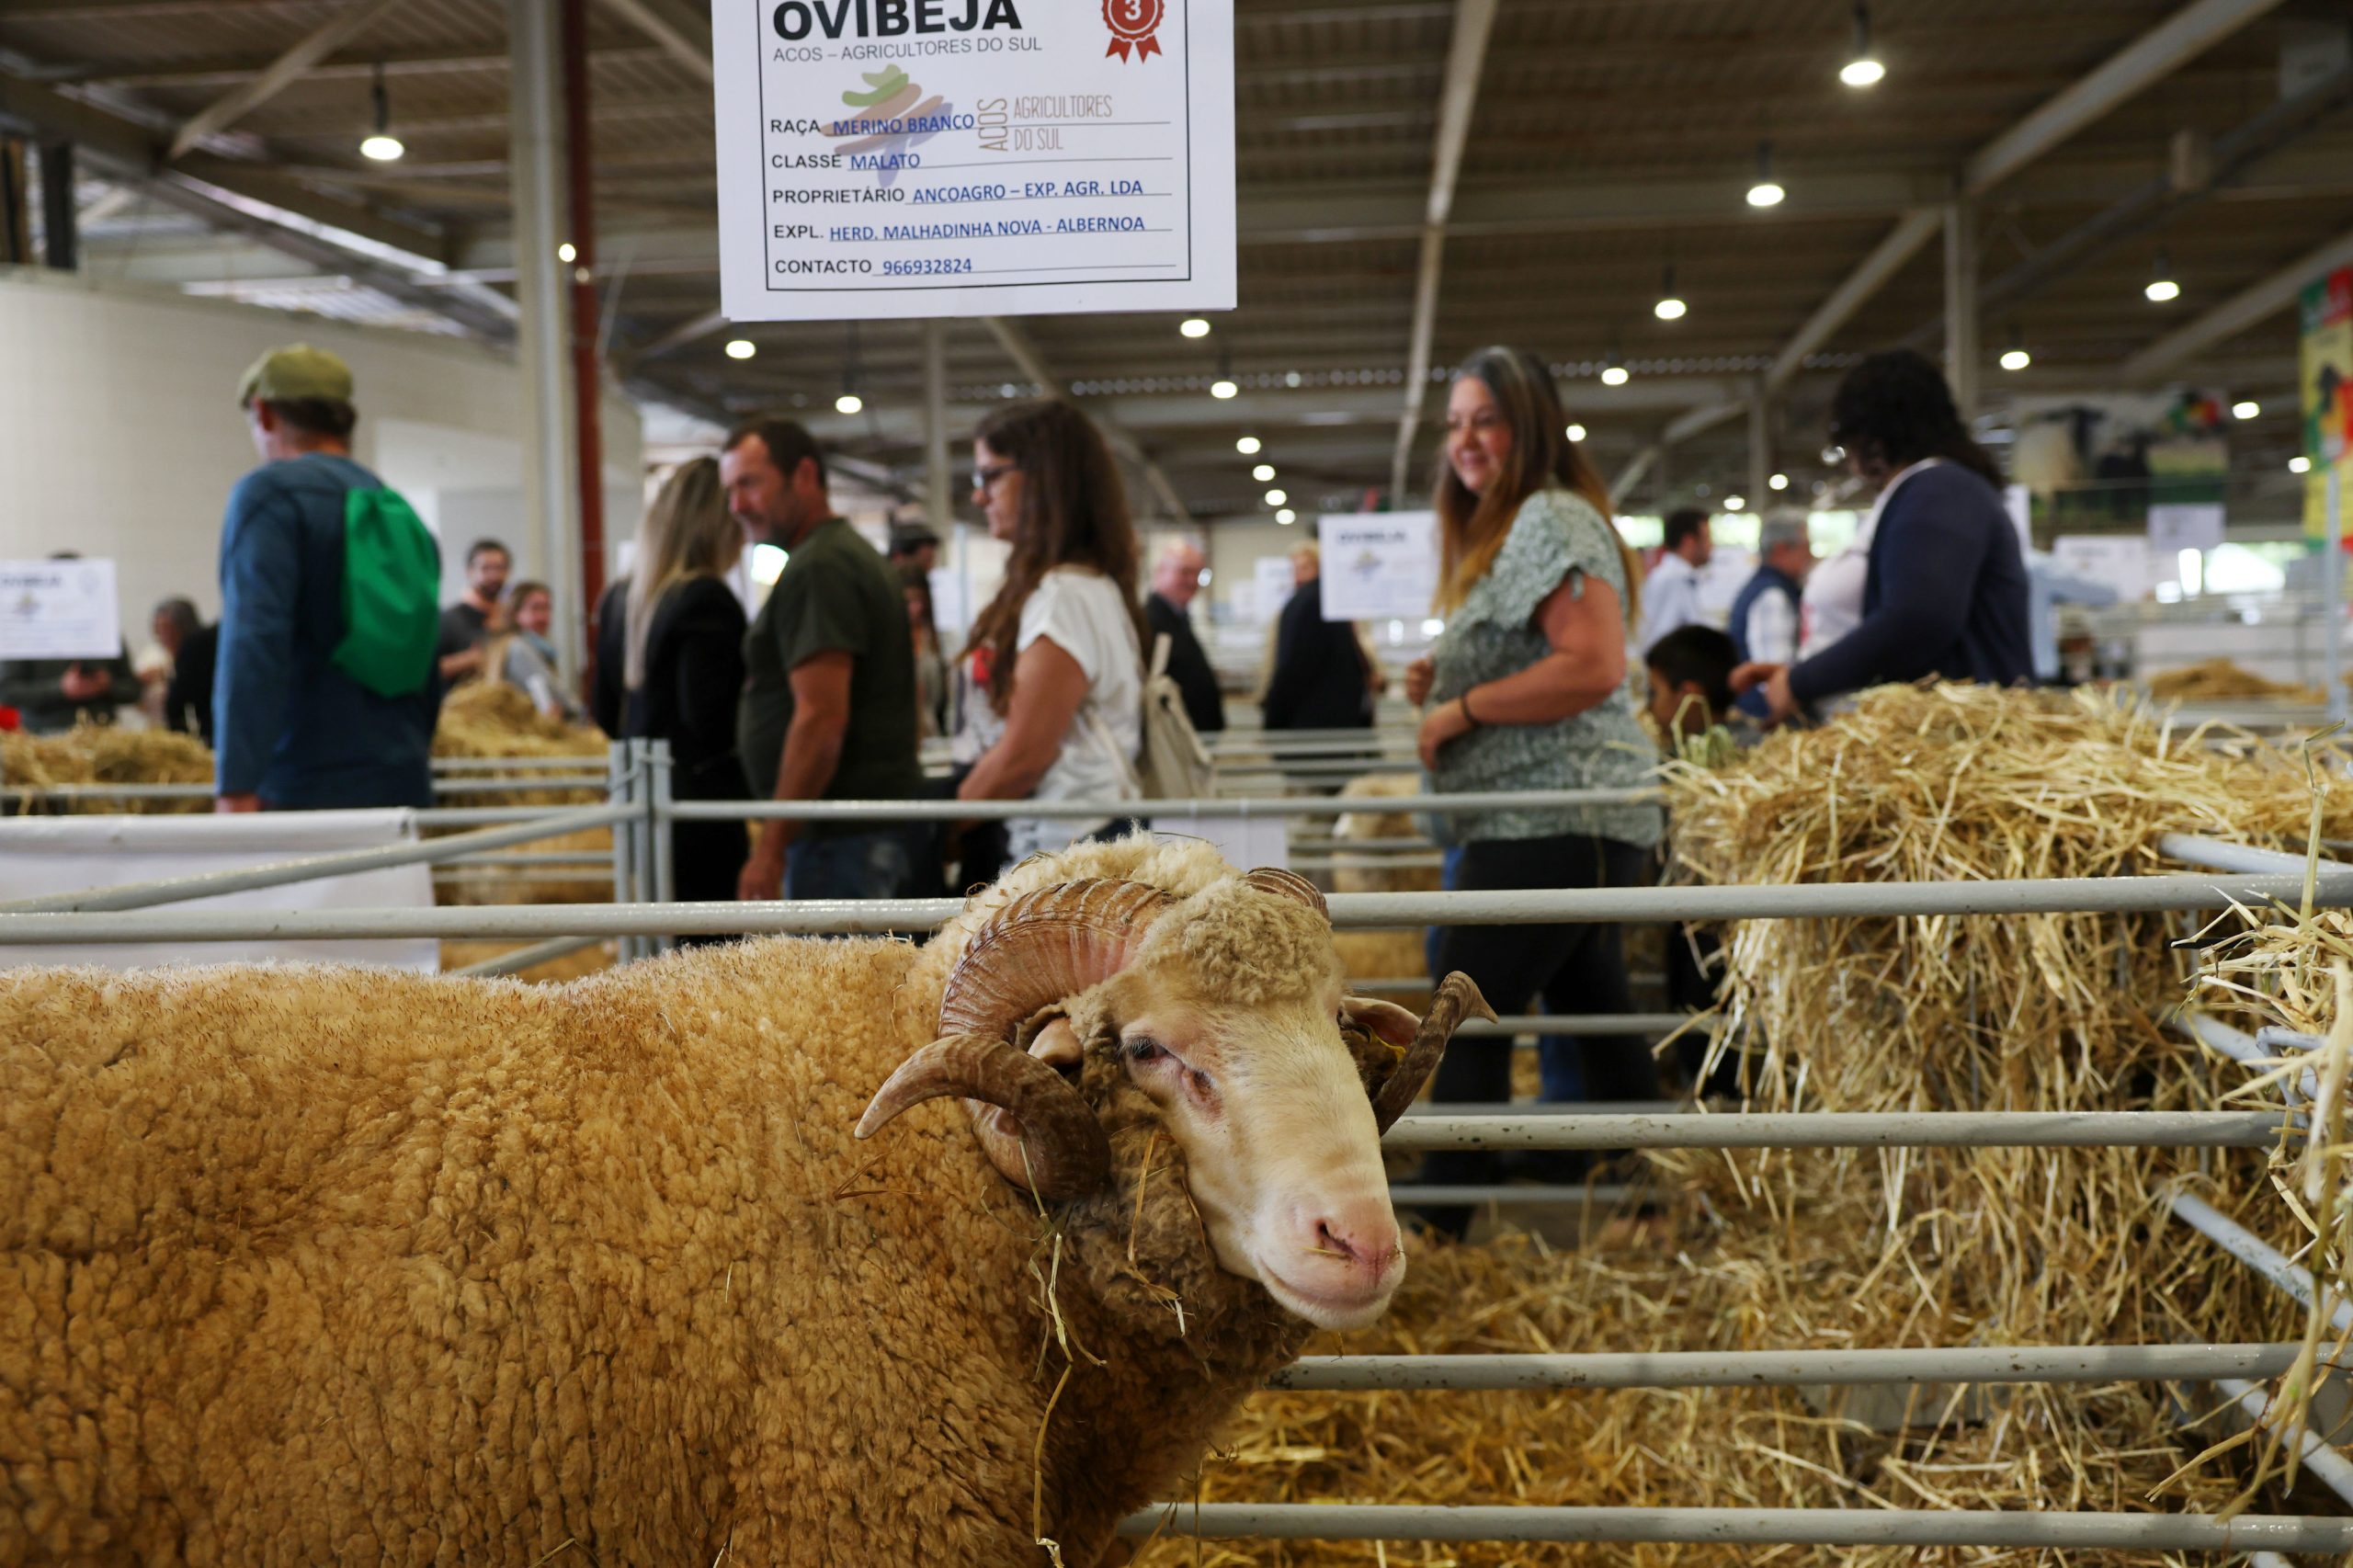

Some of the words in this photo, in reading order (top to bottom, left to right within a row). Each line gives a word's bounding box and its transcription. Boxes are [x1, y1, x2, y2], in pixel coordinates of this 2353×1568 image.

[773, 0, 1023, 40] OVIBEJA
[1124, 0, 1142, 21] 3
[773, 48, 823, 62] ACOS
[841, 39, 972, 60] AGRICULTORES
[977, 38, 1003, 52] DO
[1008, 36, 1042, 51] SUL
[1014, 95, 1112, 119] AGRICULTORES
[770, 119, 821, 136] RAÇA
[834, 118, 903, 136] MERINO
[907, 114, 974, 133] BRANCO
[977, 97, 1008, 152] ACOS
[1015, 128, 1033, 151] DO
[1037, 128, 1064, 150] SUL
[771, 154, 842, 169] CLASSE
[850, 153, 921, 170] MALATO
[773, 186, 905, 204] PROPRIETÁRIO
[913, 184, 1006, 203] ANCOAGRO
[1025, 183, 1058, 199] EXP.
[1063, 181, 1105, 196] AGR.
[1110, 180, 1143, 195] LDA
[774, 225, 824, 239] EXPL.
[830, 226, 879, 242] HERD.
[883, 222, 995, 241] MALHADINHA
[998, 220, 1041, 235] NOVA
[1057, 216, 1145, 232] ALBERNOA
[775, 259, 872, 274] CONTACTO
[883, 258, 972, 275] 966932824
